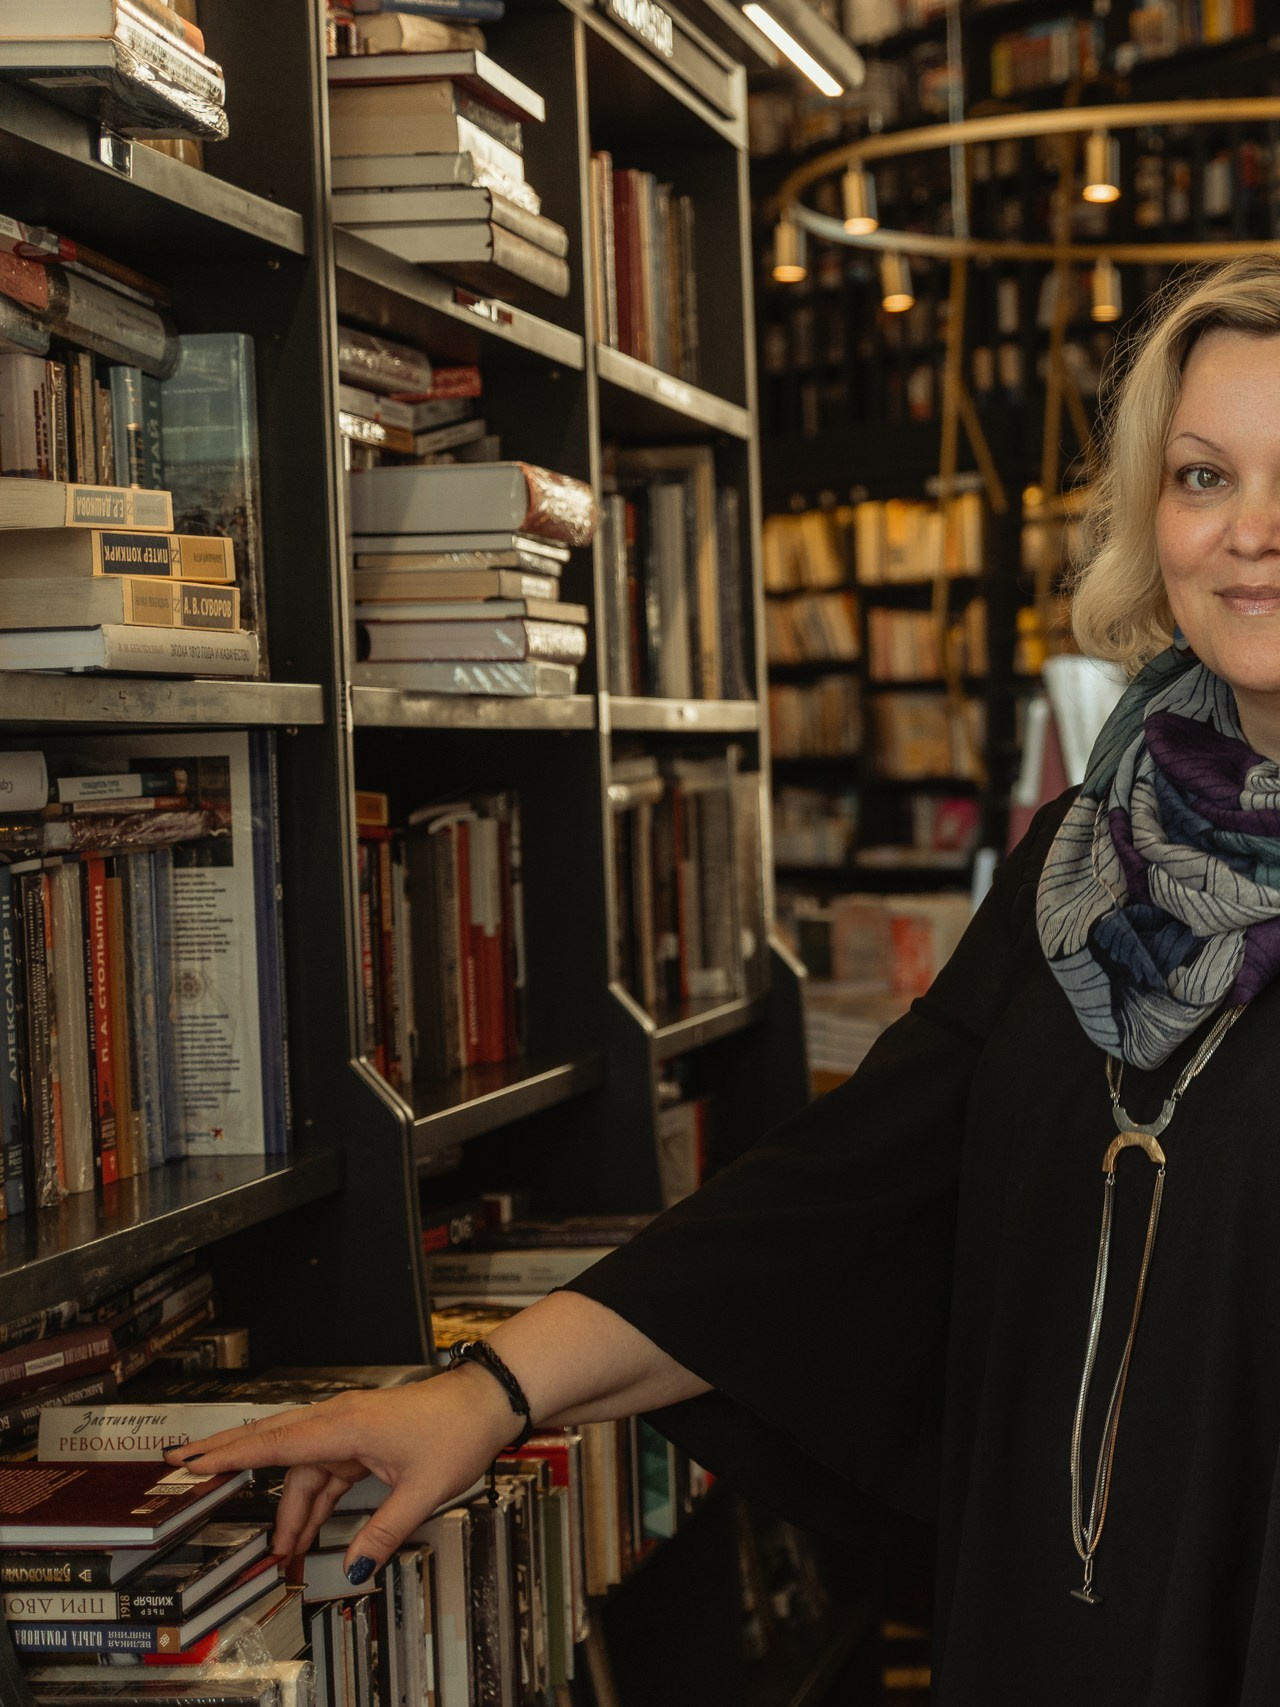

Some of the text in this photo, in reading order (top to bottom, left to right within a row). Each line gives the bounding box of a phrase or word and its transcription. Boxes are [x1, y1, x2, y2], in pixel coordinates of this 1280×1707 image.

[76, 495, 112, 519] ДАШКОВА
[104, 546, 168, 564] ПИТЕР ХОПКИРК
[201, 598, 232, 618] СУВОРОВ
[95, 885, 106, 1009] СТОЛЫПИН
[2, 895, 17, 1082] АЛЕКСАНДР III
[73, 1411, 168, 1434] Застигнутые
[59, 1433, 190, 1451] РЕВОЛЮЦИЕЙ
[4, 1598, 104, 1614] ПРИ ДВО
[120, 1595, 131, 1618] 1918
[133, 1596, 174, 1607] ЖИЛЬЯР
[15, 1629, 103, 1647] ОЛЬГА РОМАНОВА
[108, 1631, 152, 1640] КНЯГИНЯ
[108, 1639, 152, 1649] ВЕЛИКАЯ
